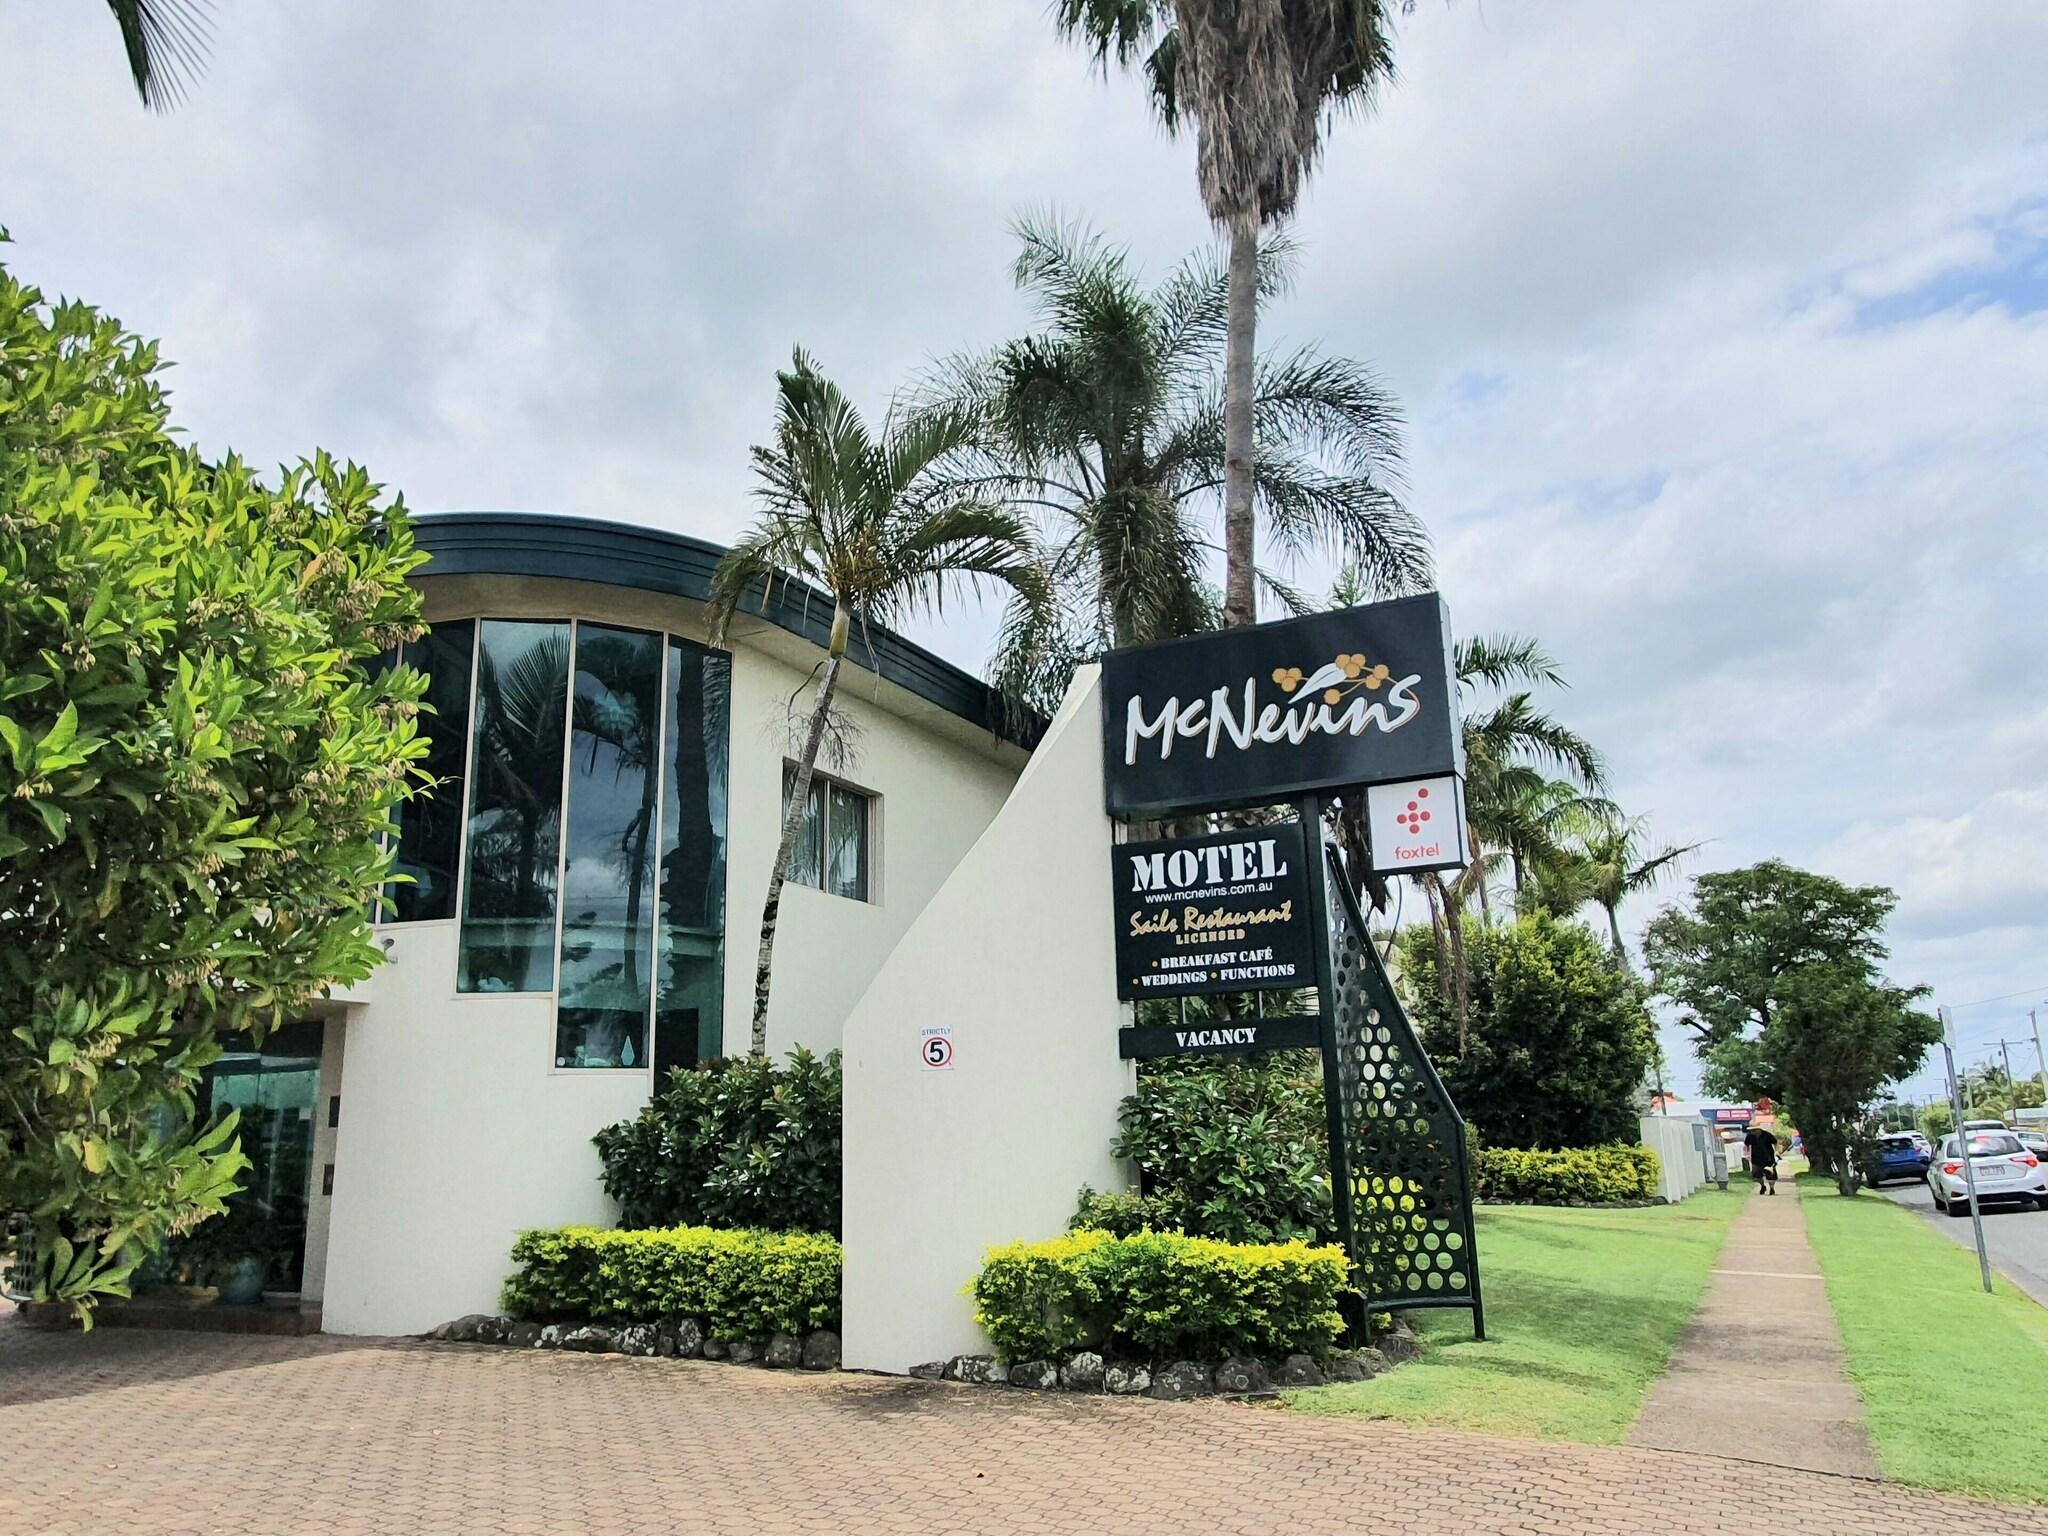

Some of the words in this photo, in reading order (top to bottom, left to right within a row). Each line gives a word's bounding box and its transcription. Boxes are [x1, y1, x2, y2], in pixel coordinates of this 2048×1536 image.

[1125, 674, 1422, 766] McNevins
[1394, 842, 1440, 860] foxtel
[1130, 840, 1288, 892] MOTEL
[1145, 882, 1273, 904] www.mcnevins.com.au
[1130, 908, 1178, 936] Sails
[1184, 899, 1292, 931] Restaurant
[1175, 929, 1246, 945] LICENSED
[1160, 952, 1237, 969] BREAKFAST
[1239, 946, 1273, 962] CAFÉ
[1141, 970, 1207, 987] WEDDINGS
[1220, 963, 1295, 980] FUNCTIONS
[921, 1028, 951, 1036] STRICTLY
[1175, 1027, 1257, 1048] VACANCY
[929, 1041, 944, 1063] 5
